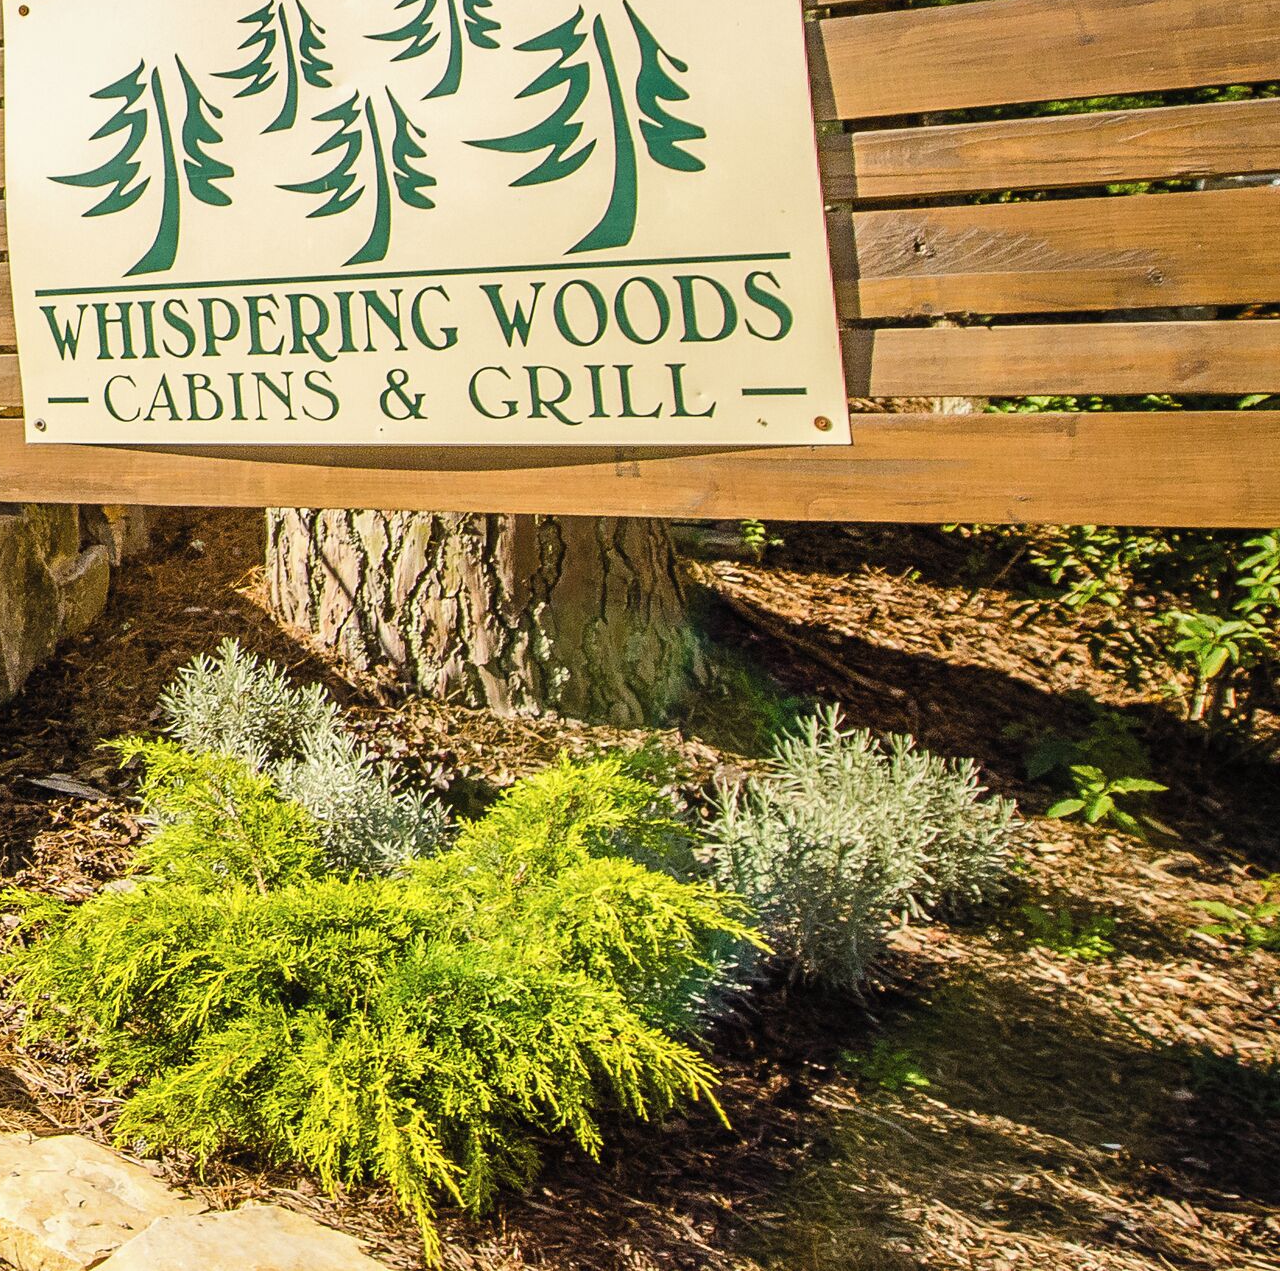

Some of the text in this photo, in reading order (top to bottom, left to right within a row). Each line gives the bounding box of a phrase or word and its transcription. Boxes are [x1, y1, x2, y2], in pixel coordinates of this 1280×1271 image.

[39, 271, 793, 363] WHISPERING WOODS
[103, 363, 717, 426] CABINS & GRILL
